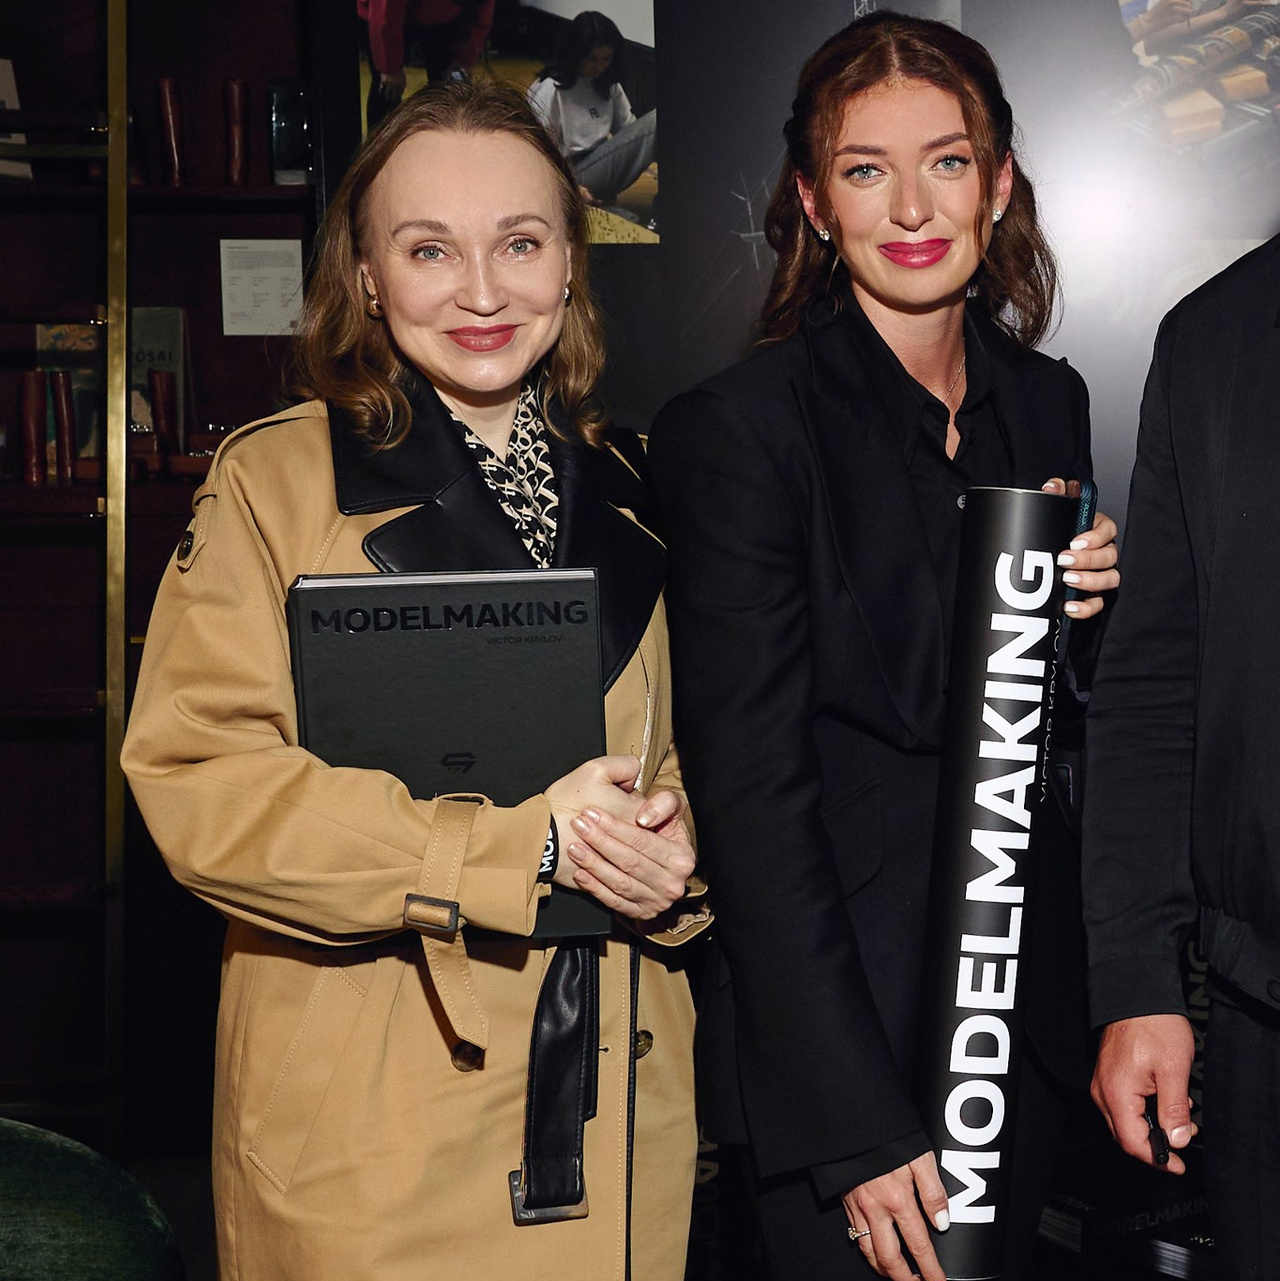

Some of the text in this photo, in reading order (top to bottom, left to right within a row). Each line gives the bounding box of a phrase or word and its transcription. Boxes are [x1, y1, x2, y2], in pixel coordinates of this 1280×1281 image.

[310, 599, 589, 634] MODELMAKING
[486, 634, 564, 646] VICTOR KRYLOV
[941, 548, 1056, 1225] MODELMAKING
[1094, 1196, 1209, 1237] MODELMAKIN
